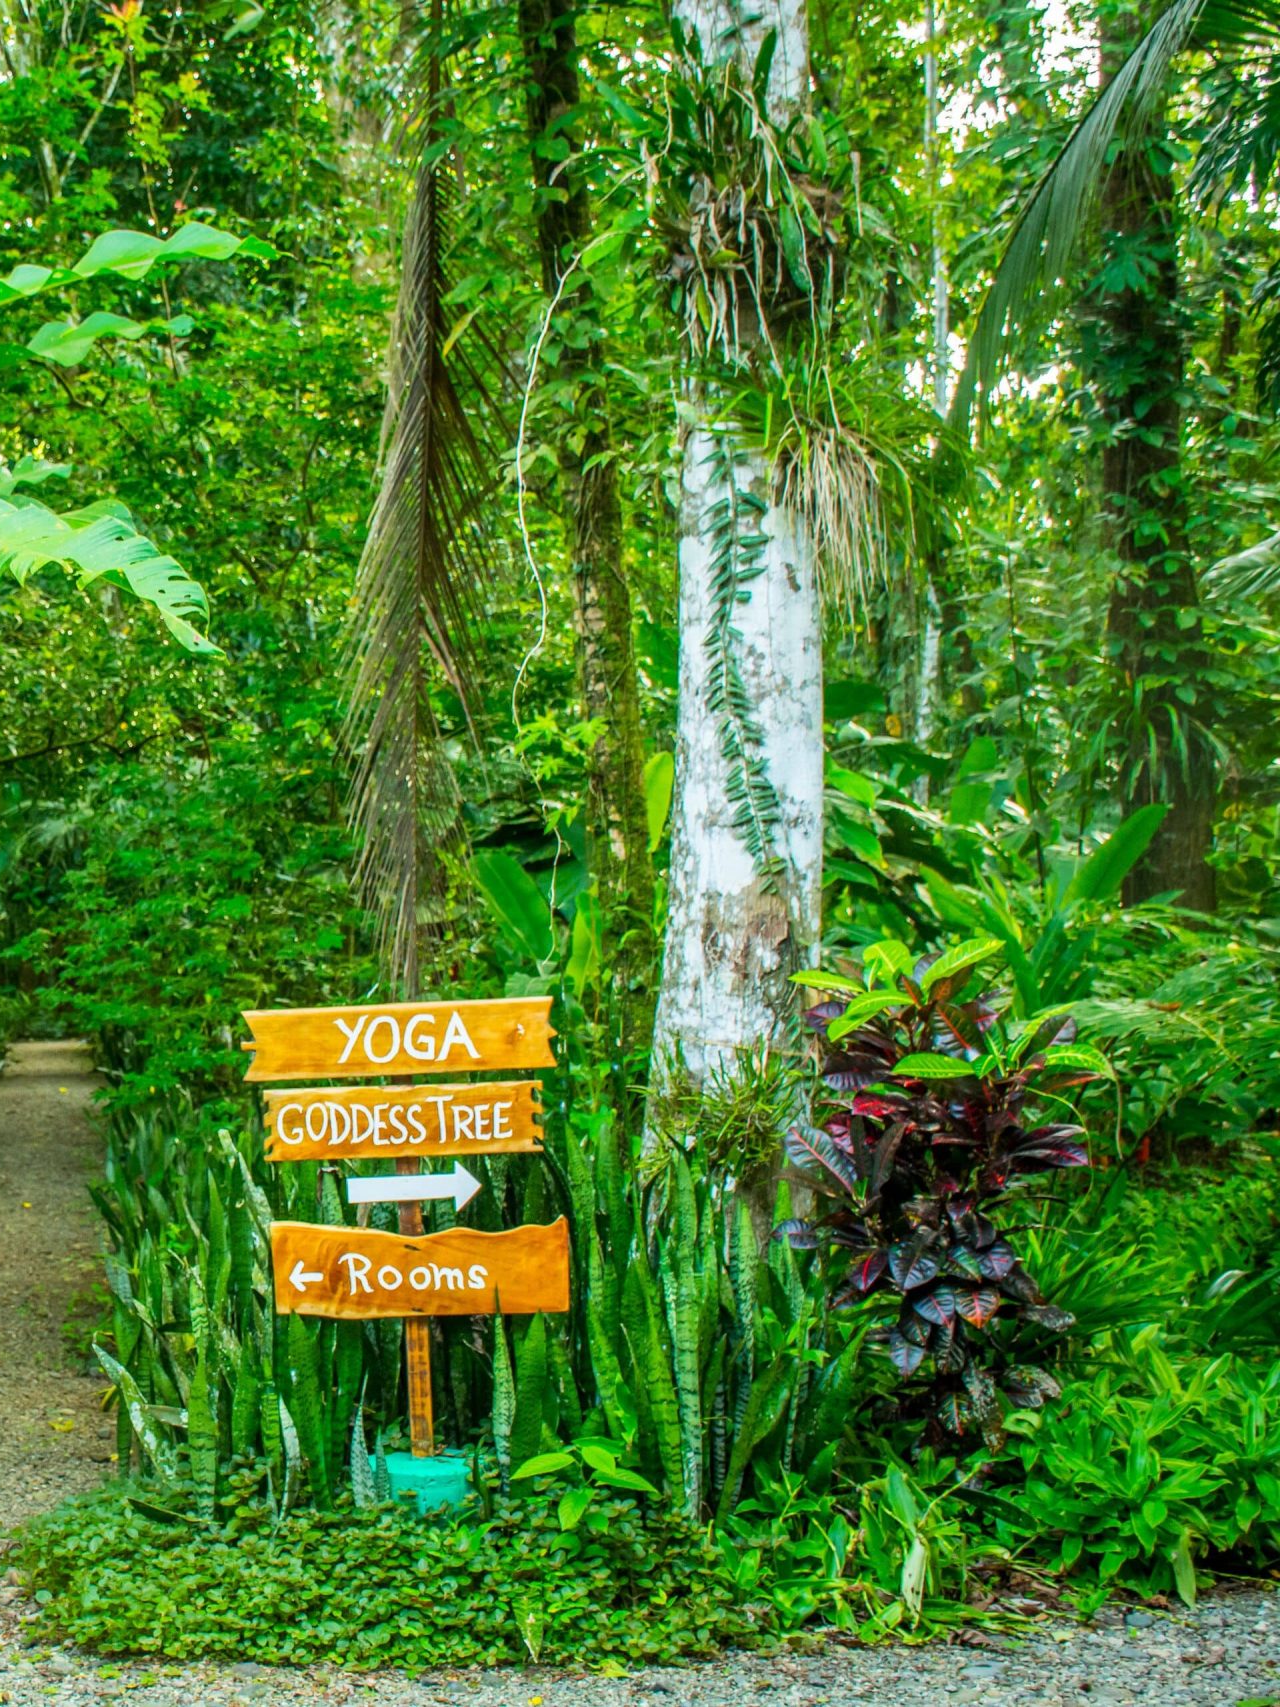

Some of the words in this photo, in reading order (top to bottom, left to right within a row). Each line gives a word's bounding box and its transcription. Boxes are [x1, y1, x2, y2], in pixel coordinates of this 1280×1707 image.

[333, 1010, 482, 1064] YOGA
[276, 1101, 426, 1146] GODDESS
[425, 1095, 514, 1144] TREE
[338, 1252, 489, 1296] Rooms
